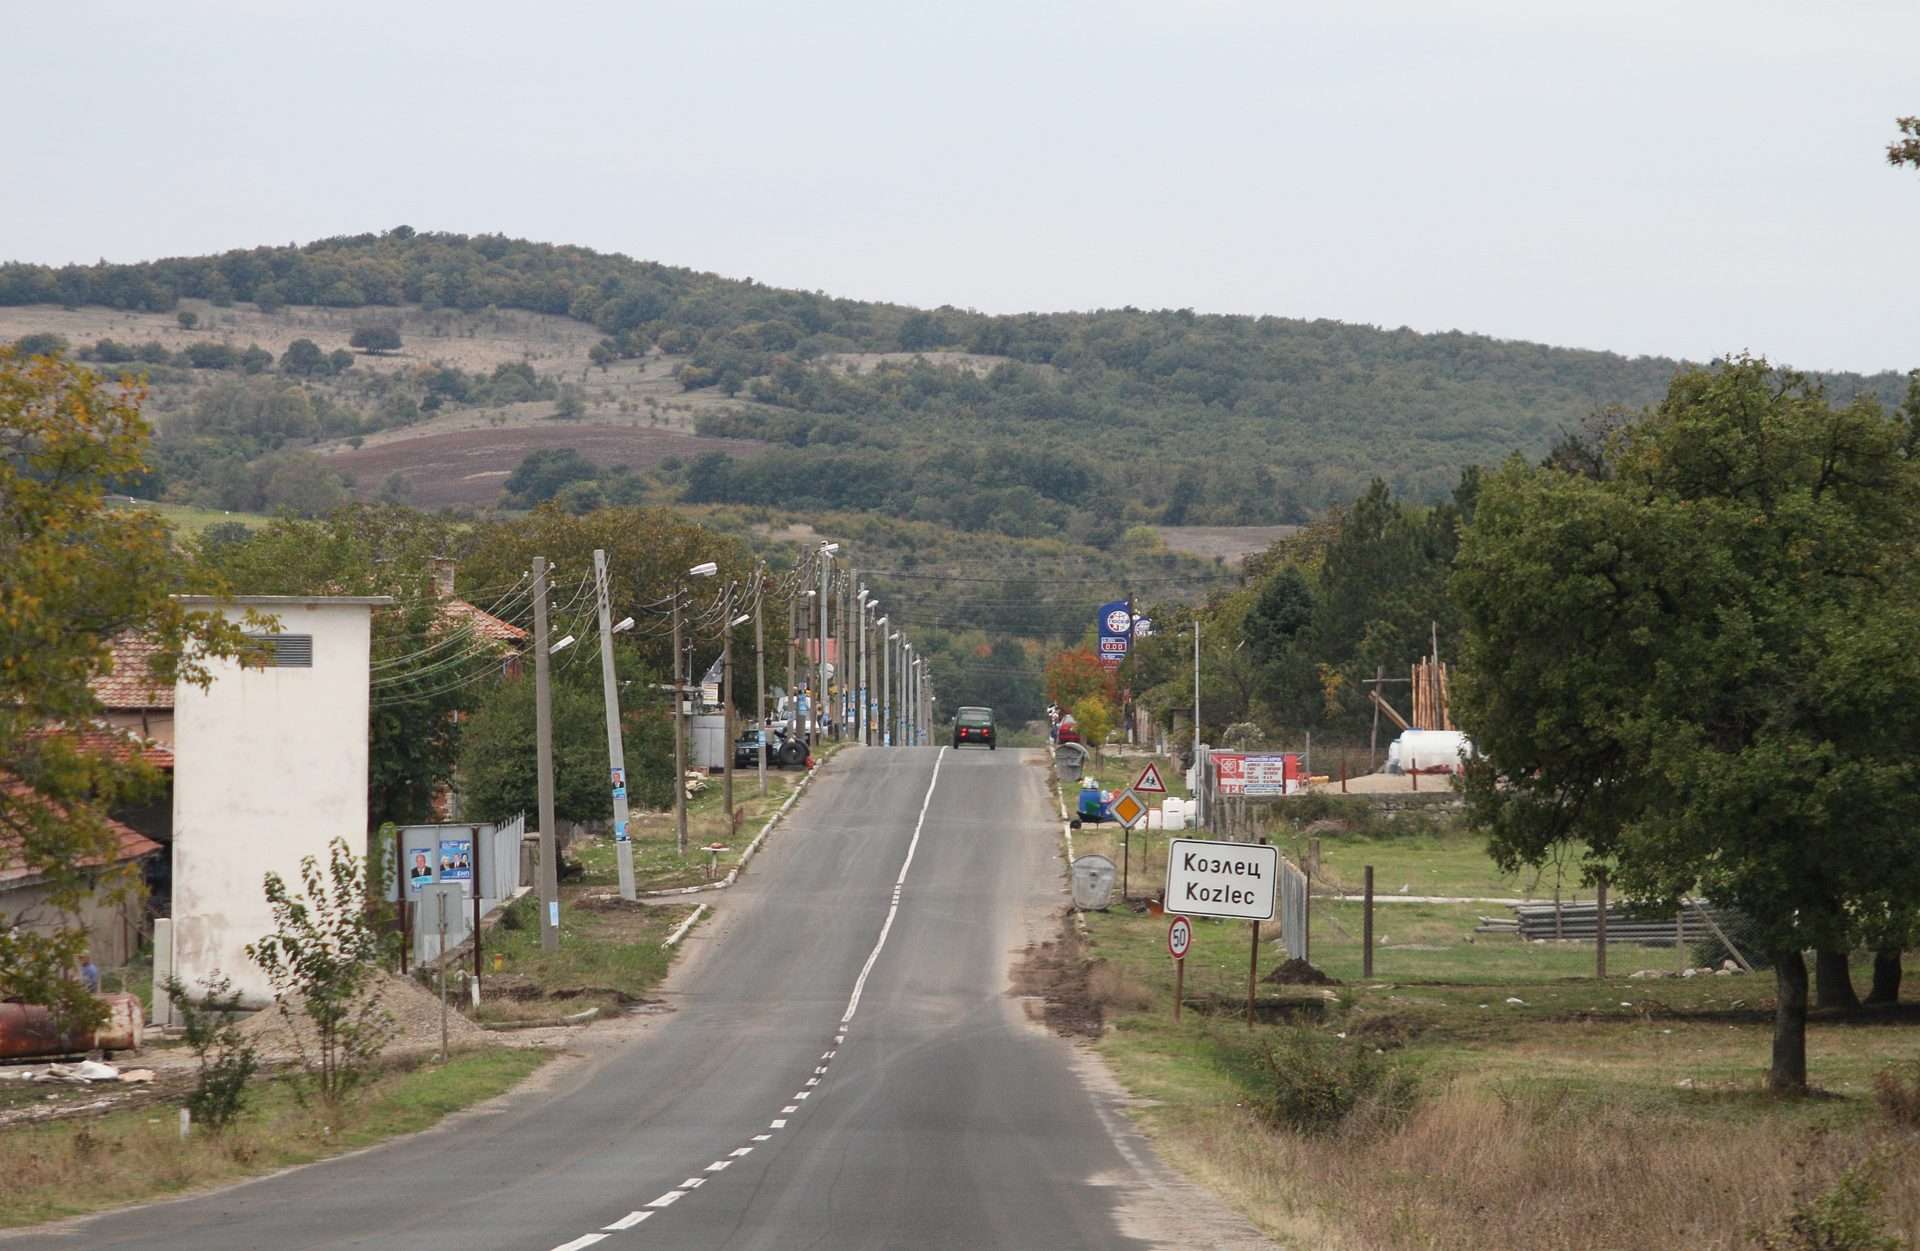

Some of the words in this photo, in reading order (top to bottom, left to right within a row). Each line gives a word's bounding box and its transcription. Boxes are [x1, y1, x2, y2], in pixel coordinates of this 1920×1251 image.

[1184, 853, 1261, 879] Козлец
[1186, 882, 1255, 905] Kozlec
[1173, 929, 1186, 947] 50
